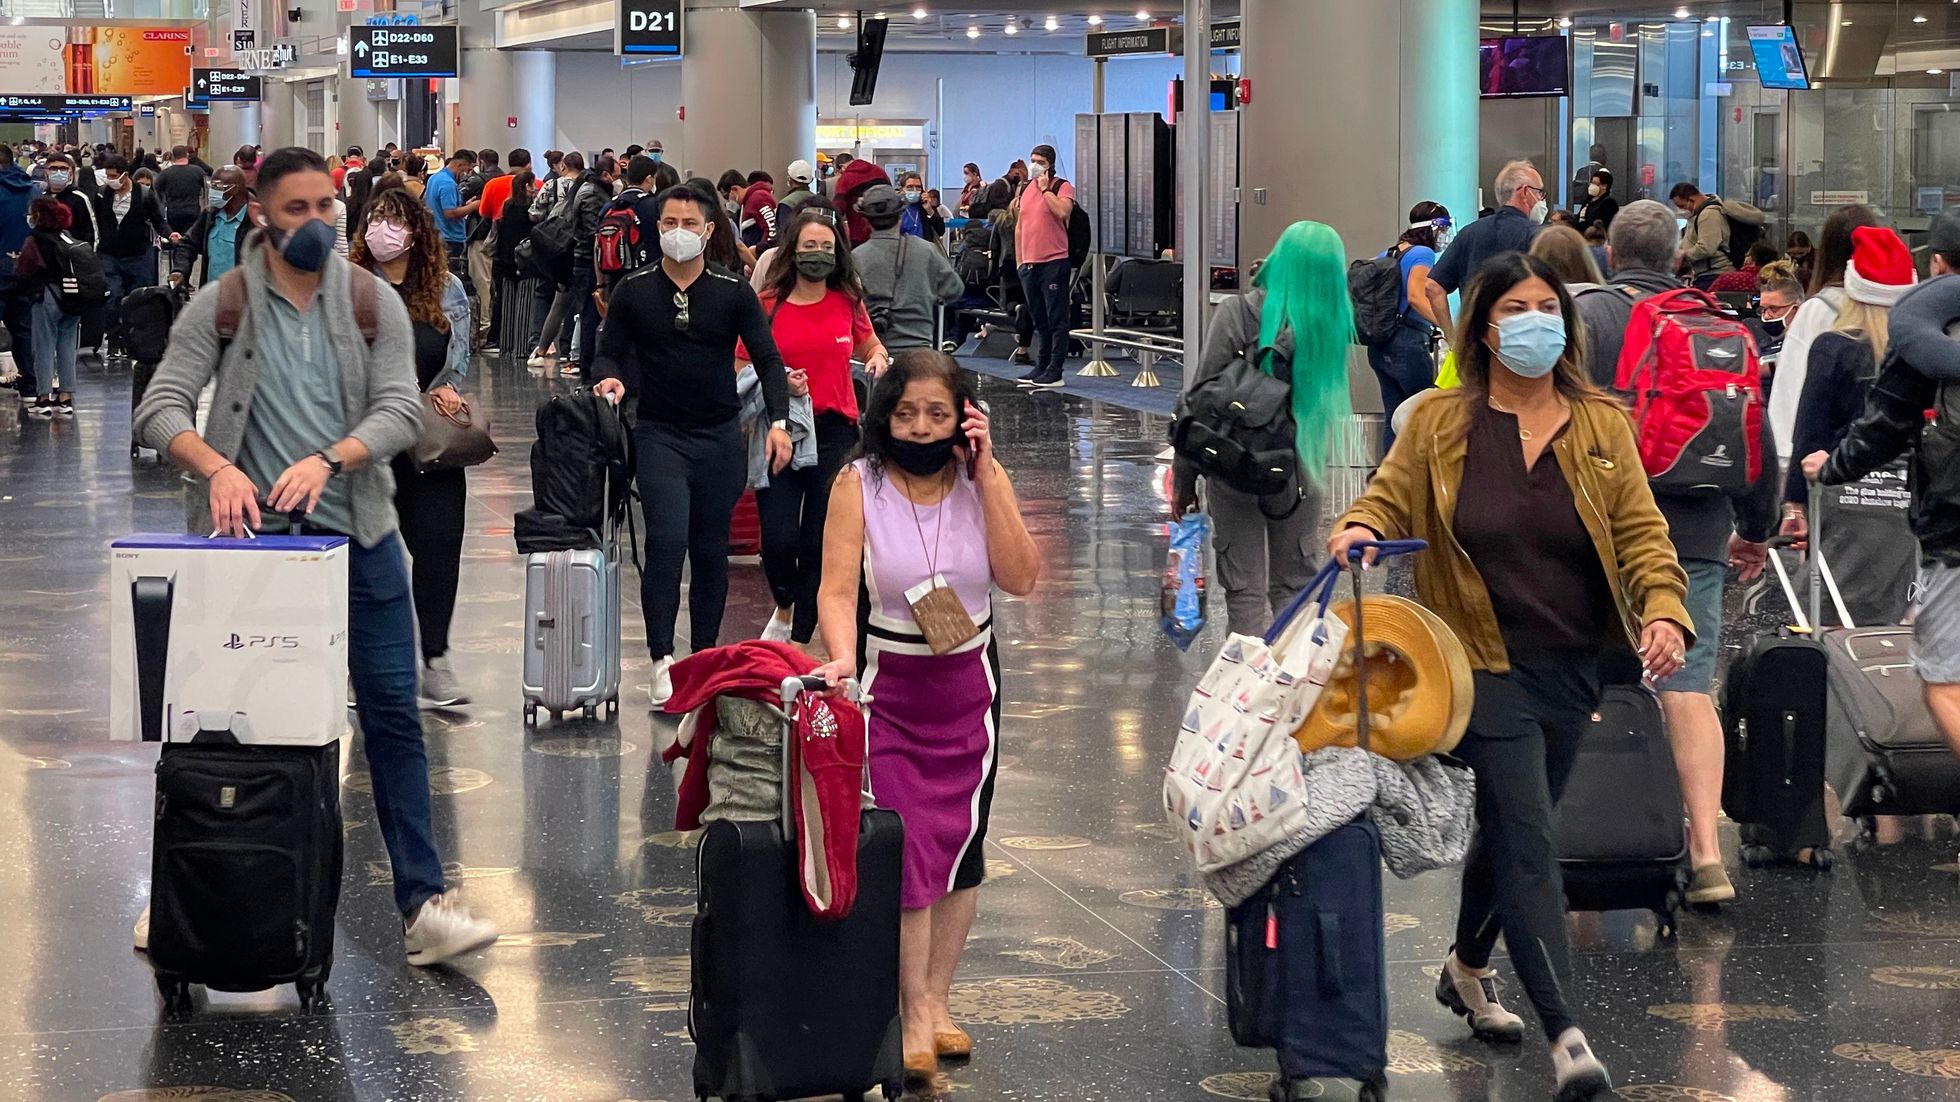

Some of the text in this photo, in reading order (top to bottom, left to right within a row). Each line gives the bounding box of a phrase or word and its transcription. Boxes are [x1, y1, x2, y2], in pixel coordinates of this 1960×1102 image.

[630, 11, 674, 31] D21
[143, 32, 188, 40] CLARINS
[389, 33, 434, 43] D22-D60
[1226, 27, 1241, 41] INFO
[1101, 35, 1149, 50] FLIGHT INFORMATION
[390, 55, 428, 64] E1-E33
[249, 636, 298, 648] PS5
